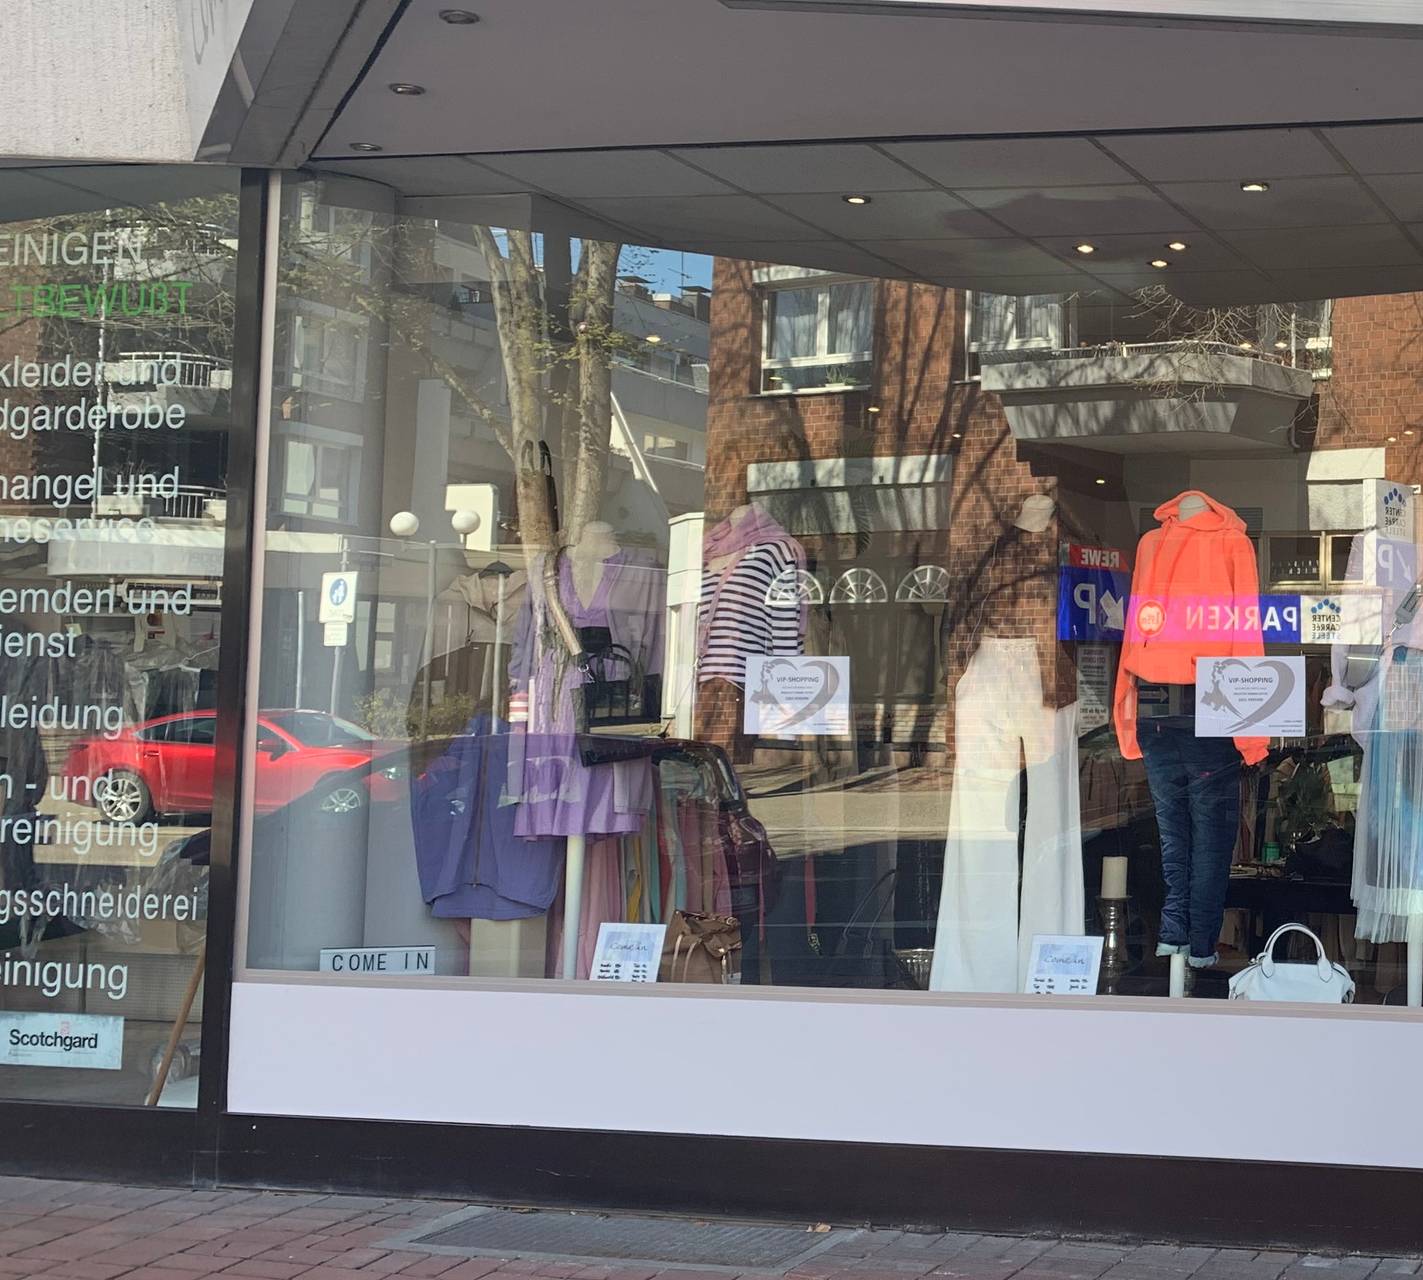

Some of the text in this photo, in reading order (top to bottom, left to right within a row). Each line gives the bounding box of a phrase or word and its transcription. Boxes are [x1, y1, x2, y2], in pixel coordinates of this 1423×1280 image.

[117, 352, 182, 386] und
[116, 466, 180, 499] und
[128, 581, 192, 615] und
[50, 768, 114, 801] und
[0, 953, 128, 1000] inigung
[332, 952, 430, 973] COME IN
[9, 1028, 99, 1052] Scotchgard
